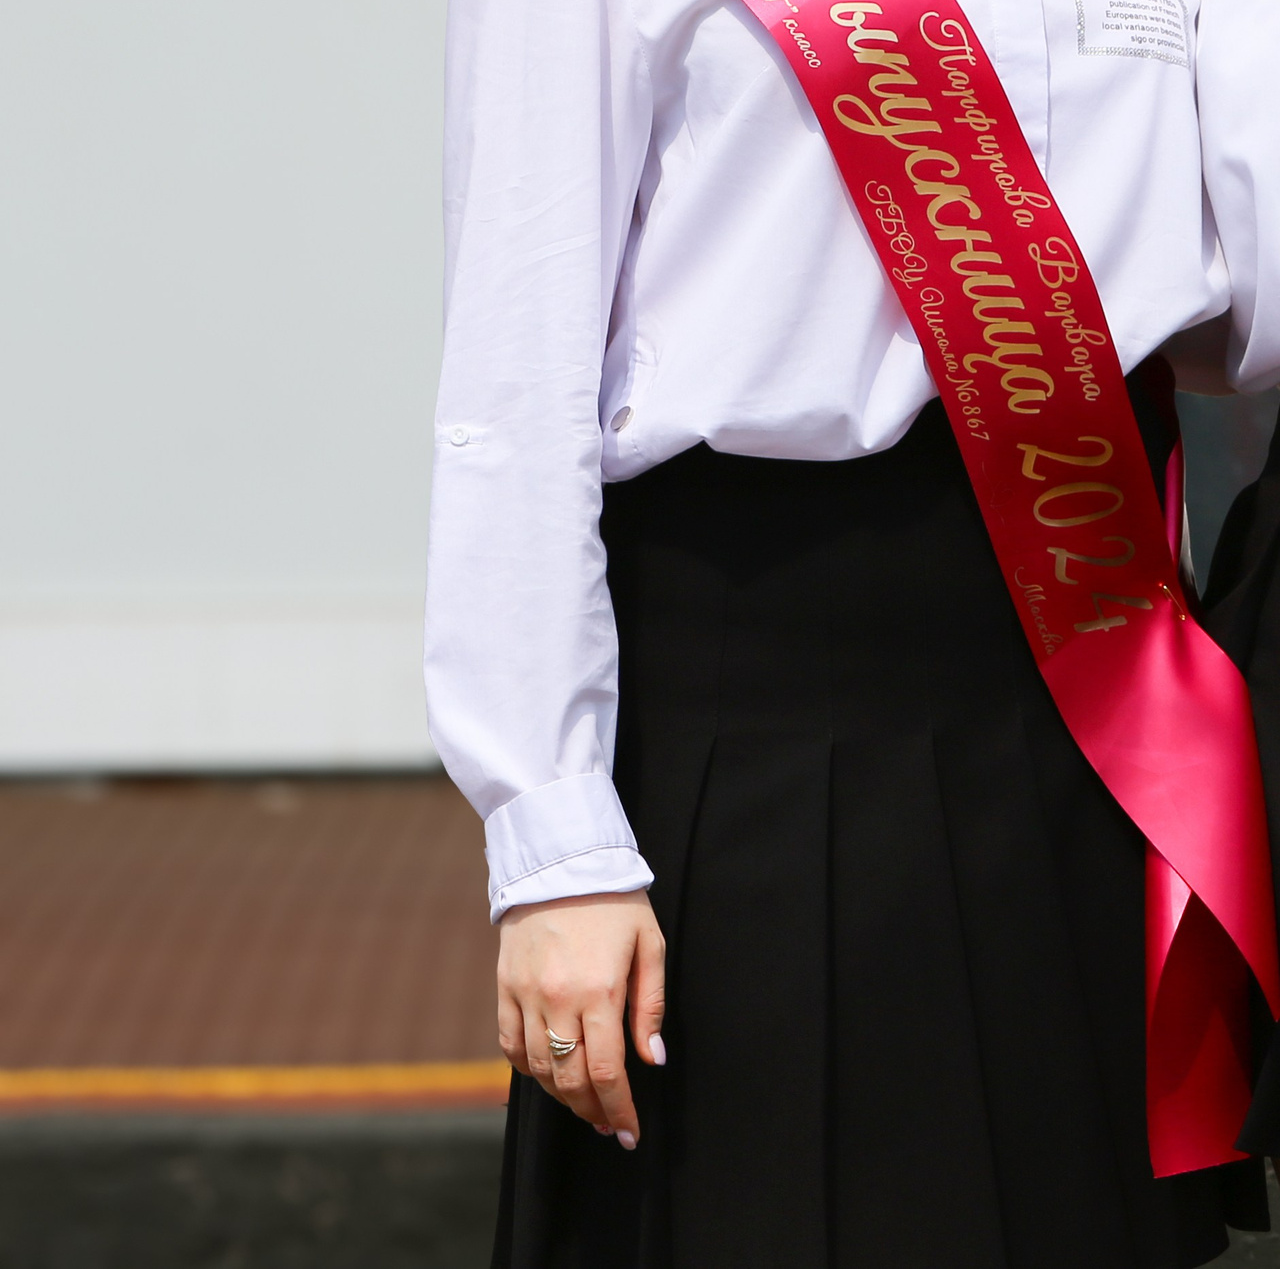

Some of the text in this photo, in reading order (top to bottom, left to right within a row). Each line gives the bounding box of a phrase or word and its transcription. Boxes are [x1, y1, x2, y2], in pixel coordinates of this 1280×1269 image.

[1101, 21, 1123, 31] local
[1105, 10, 1148, 21] Europeans
[1109, 0, 1151, 11] publication
[781, 17, 822, 69] класс
[918, 10, 1107, 402] Парфирова Варвара
[864, 180, 929, 289] ГБОУ
[919, 287, 960, 373] Школа
[1015, 435, 1154, 635] 2024
[1014, 566, 1064, 654] Москва
